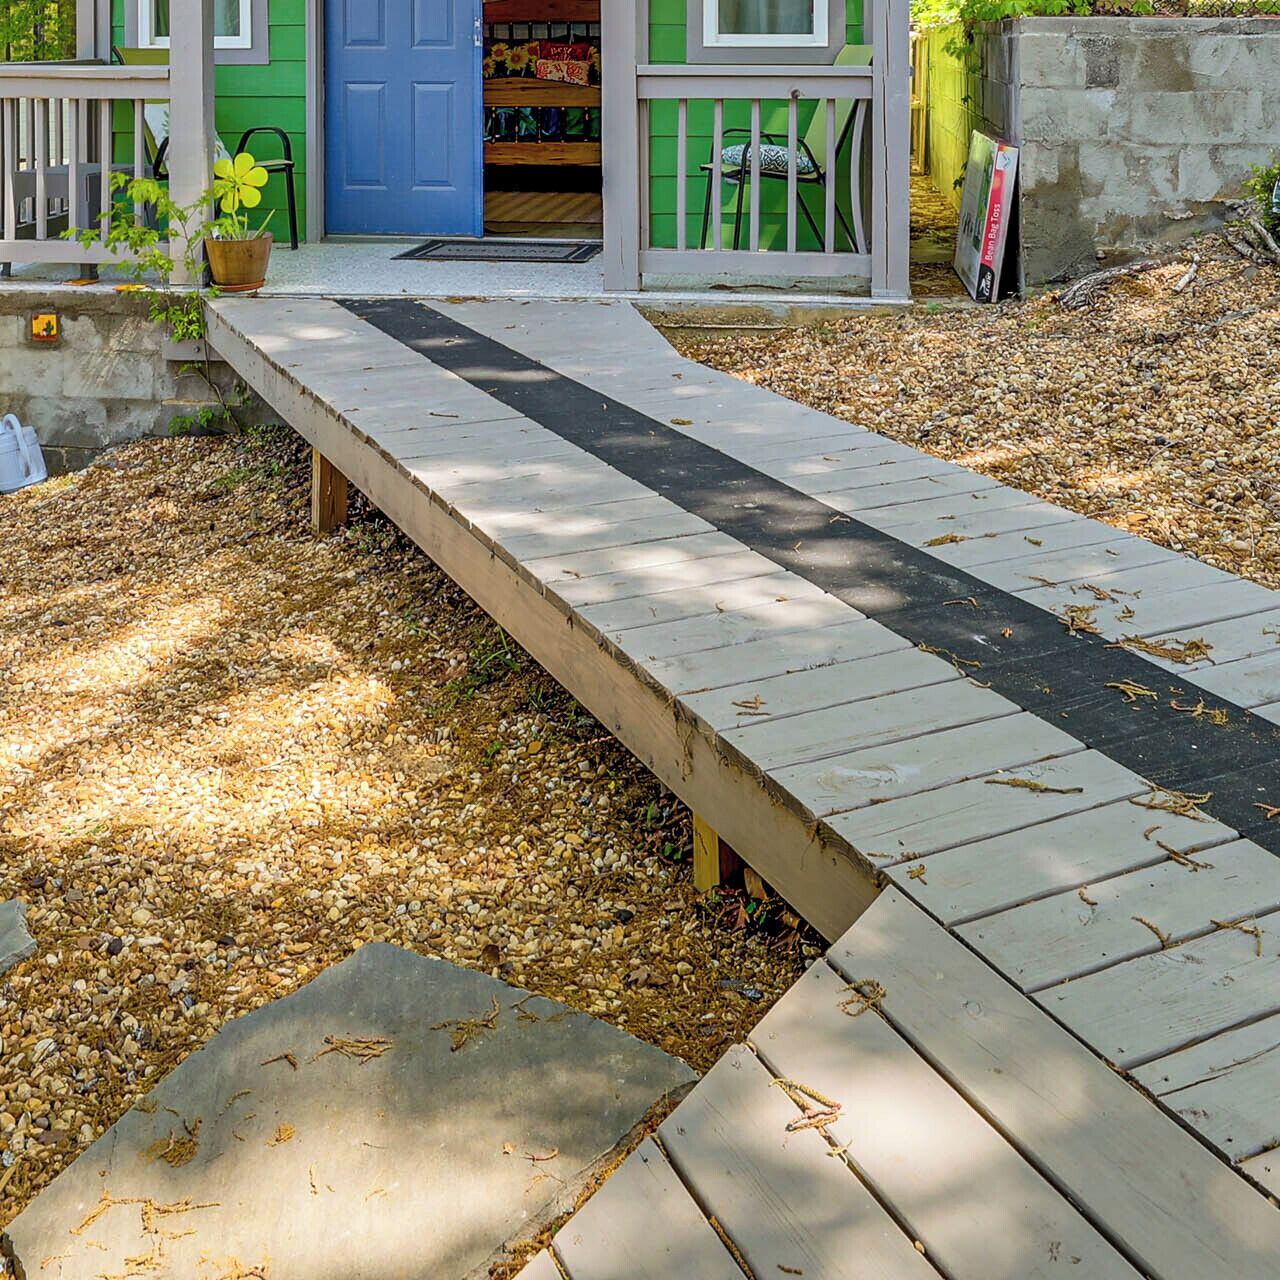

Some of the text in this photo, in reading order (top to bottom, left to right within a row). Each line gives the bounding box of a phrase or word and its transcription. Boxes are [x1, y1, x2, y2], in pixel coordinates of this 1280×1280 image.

[985, 203, 1000, 260] Bean Bag Toss
